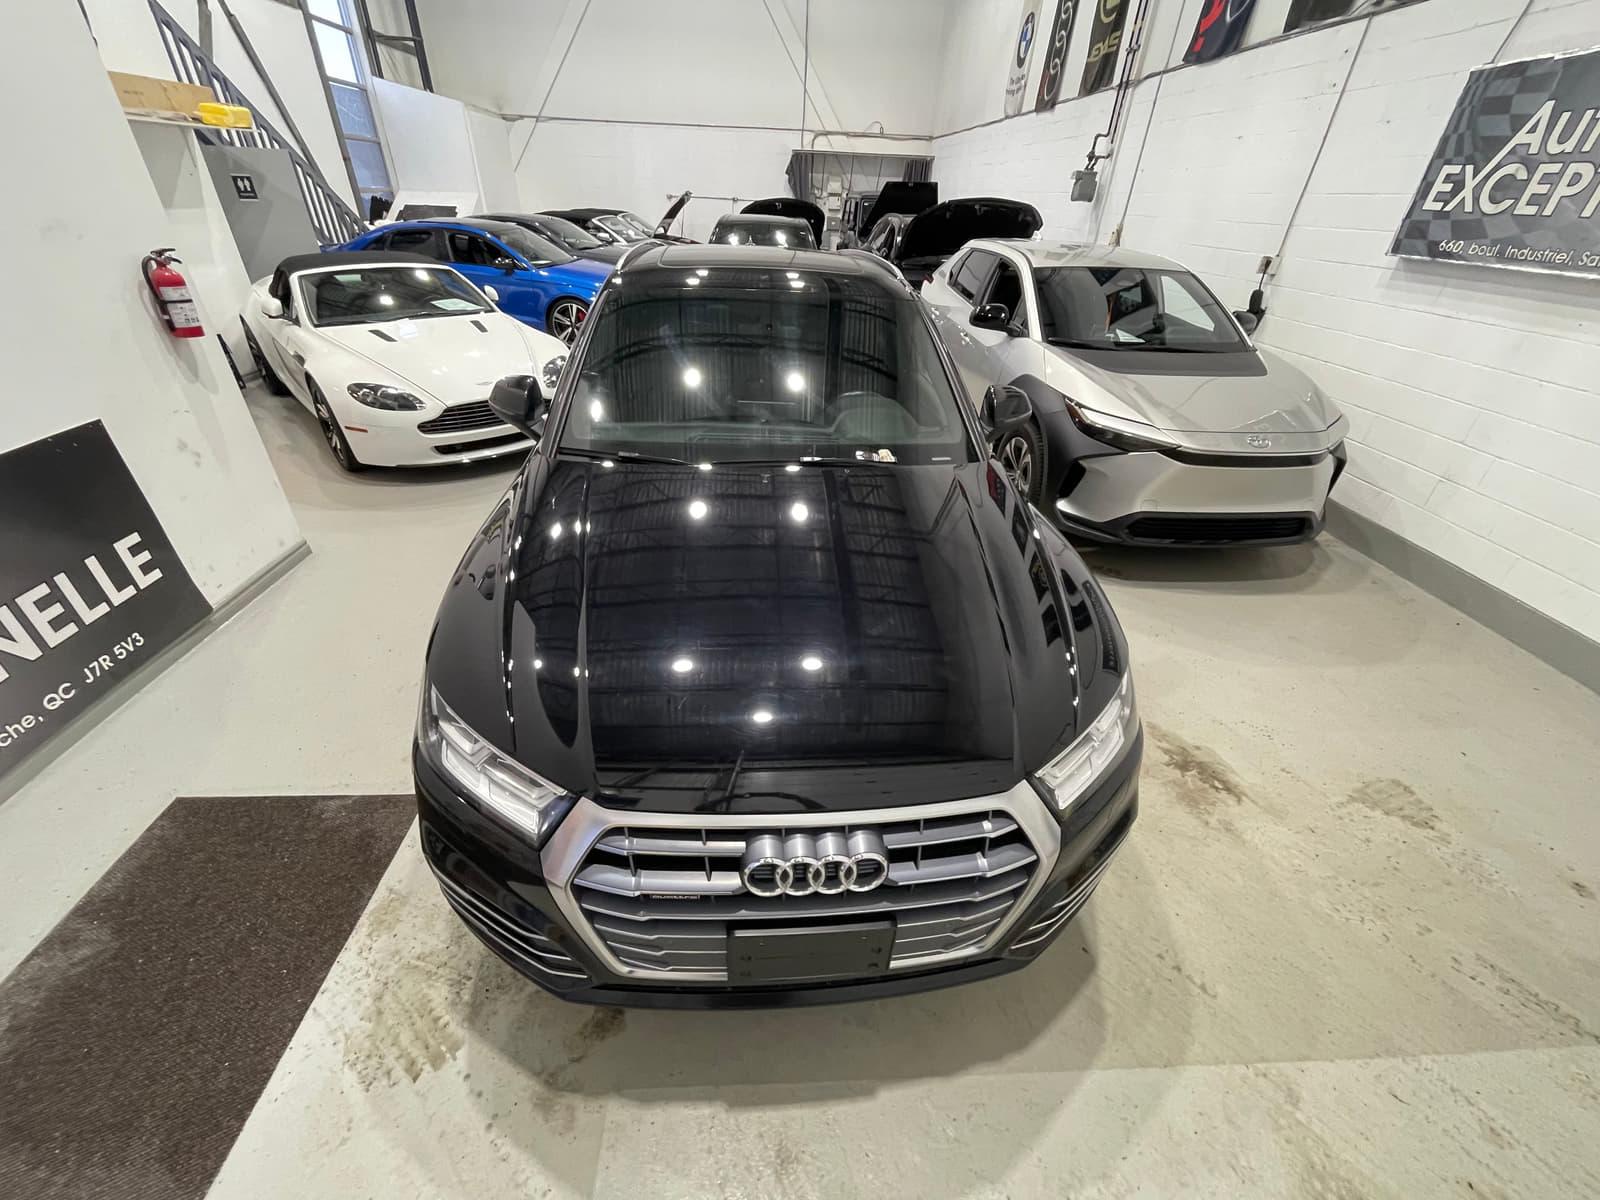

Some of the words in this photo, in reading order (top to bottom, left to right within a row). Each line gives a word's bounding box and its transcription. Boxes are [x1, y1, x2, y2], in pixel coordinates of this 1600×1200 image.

[1467, 242, 1500, 257] boul.
[1504, 244, 1573, 265] Industriel,
[0, 531, 164, 684] NELLE
[43, 682, 76, 710] QC
[83, 655, 115, 684] J7R
[113, 632, 145, 660] 5V3
